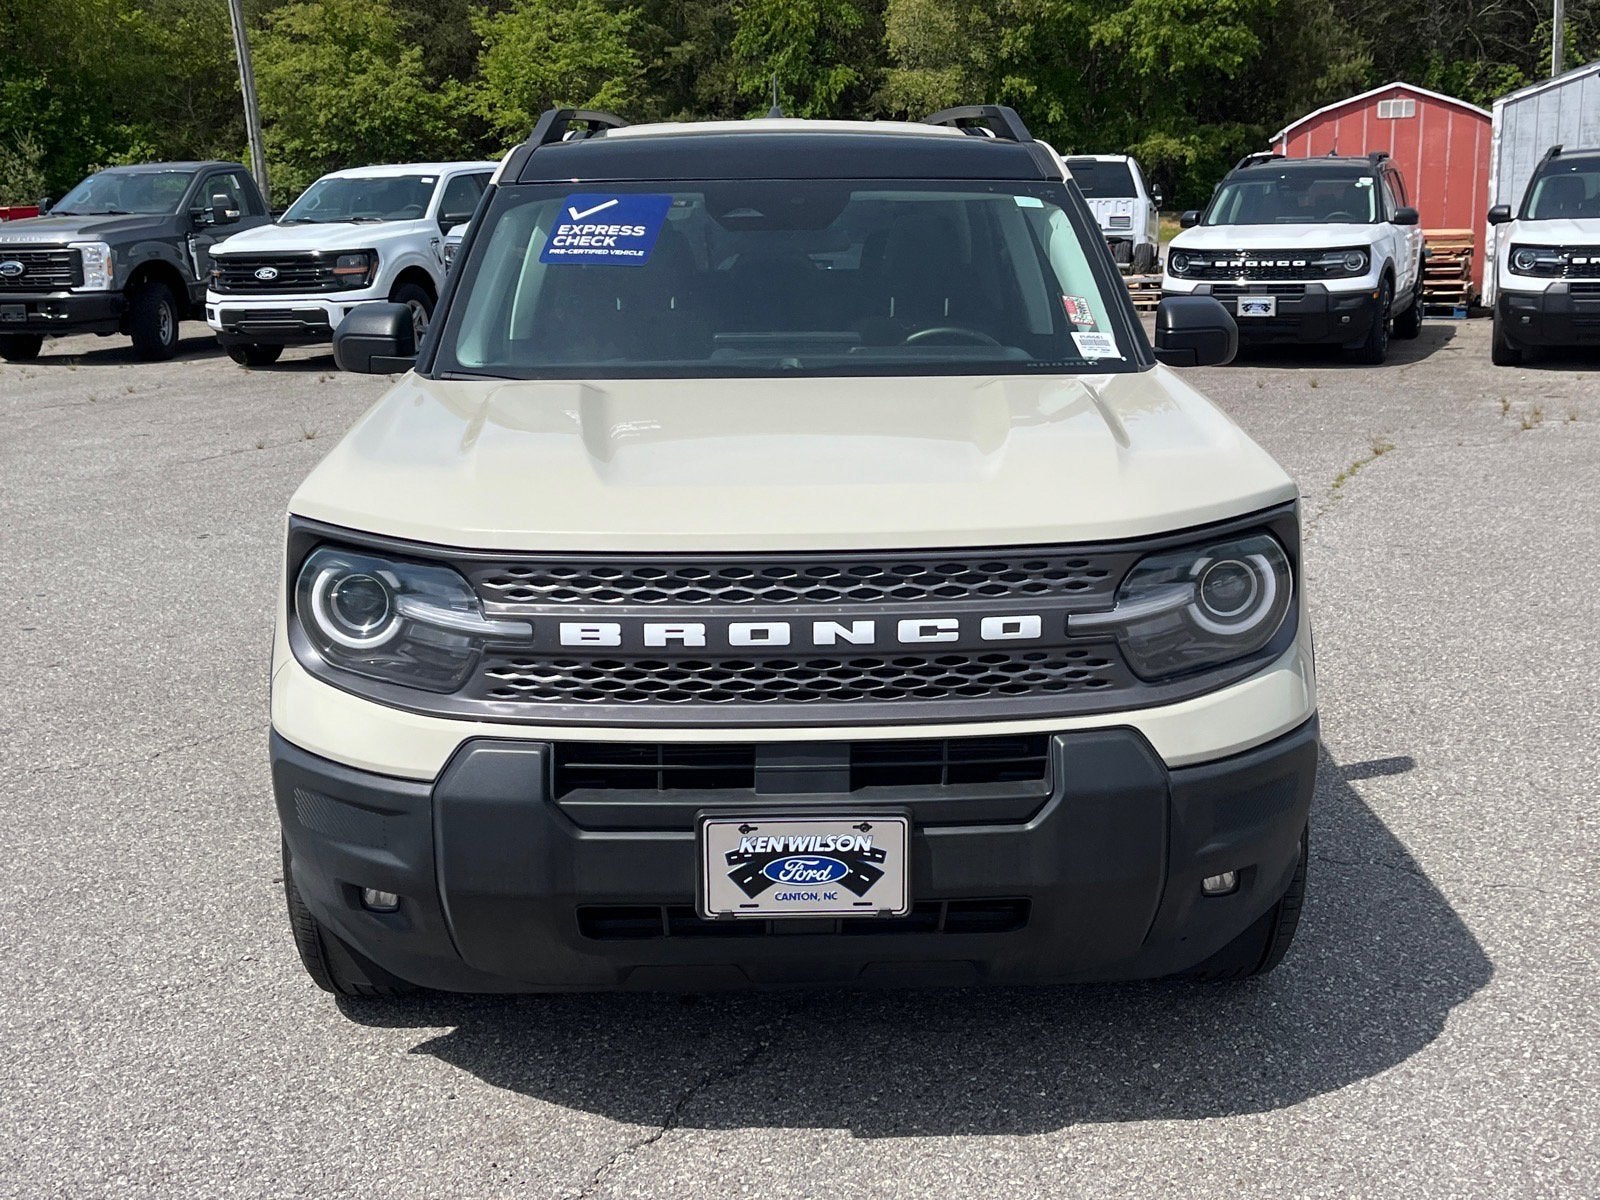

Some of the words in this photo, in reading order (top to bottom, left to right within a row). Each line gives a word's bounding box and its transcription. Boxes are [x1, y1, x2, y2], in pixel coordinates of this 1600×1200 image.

[557, 224, 646, 236] EXPRESS
[552, 236, 617, 247] CHECK
[548, 248, 609, 256] PRE-CERTIFIED
[610, 249, 645, 257] VEHICLE
[559, 615, 1042, 647] BRONCO
[739, 836, 785, 853] KEN
[786, 834, 873, 853] WILSON
[778, 859, 832, 882] Ford
[774, 892, 820, 902] CANTON,
[823, 891, 838, 901] NC
